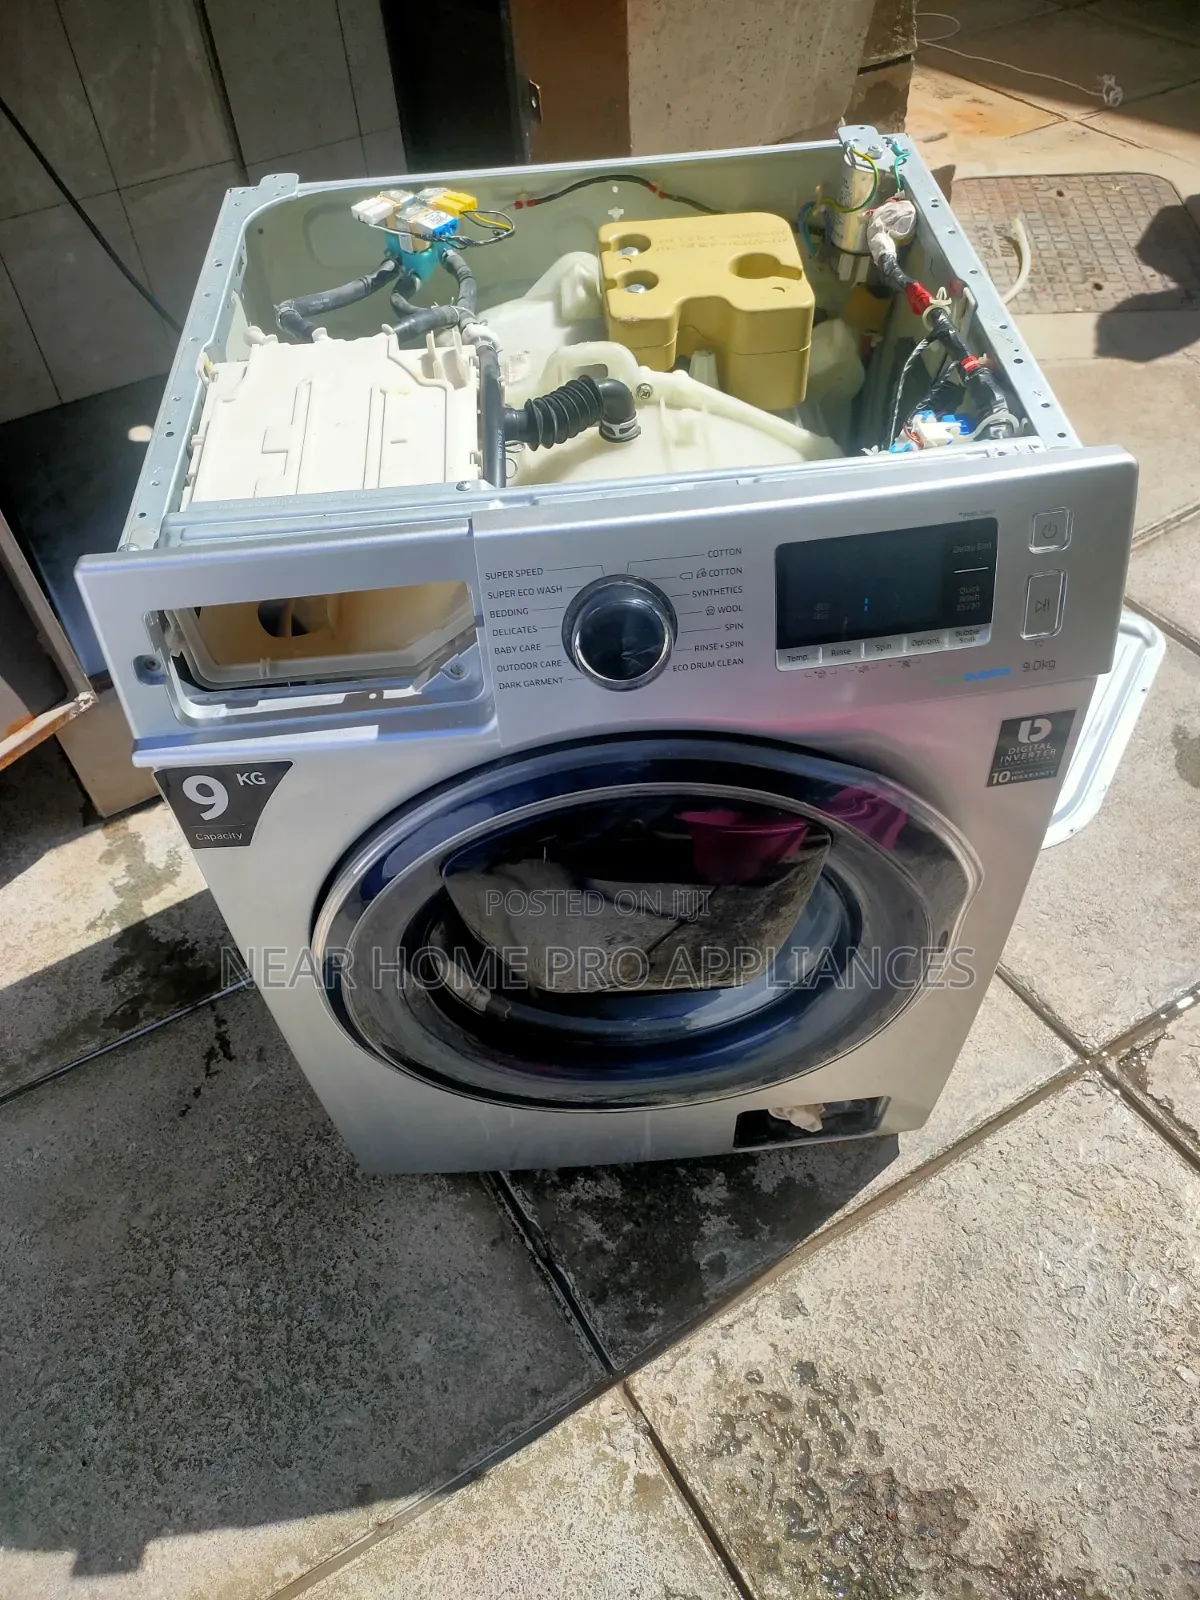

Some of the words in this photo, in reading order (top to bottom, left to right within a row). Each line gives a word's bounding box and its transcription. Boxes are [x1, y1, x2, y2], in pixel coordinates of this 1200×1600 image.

[707, 548, 742, 558] COTTON
[485, 570, 513, 580] SUPER
[516, 568, 543, 577] SPEED
[709, 567, 743, 577] COTTON
[488, 590, 515, 599] SUPER
[518, 588, 535, 597] ECO
[537, 586, 563, 595] WASH
[692, 586, 743, 598] SYNTHETICS
[490, 608, 529, 618] BEDDING
[717, 605, 743, 614] WOOL
[492, 626, 538, 636] DELICATES
[724, 623, 744, 631] SPIN
[694, 643, 718, 652] RINSE
[725, 640, 744, 649] SPIN
[875, 643, 892, 652] Spin
[911, 637, 940, 647] Options
[494, 646, 517, 655] BABY
[520, 644, 542, 653] CARE
[831, 648, 852, 657] Rinse
[497, 662, 538, 672] OUTDOOR
[540, 660, 562, 669] CARE
[672, 663, 689, 672] ECO
[691, 661, 715, 670] DRUM
[717, 658, 744, 667] CLEAN
[1022, 659, 1056, 672] 9.0kg
[499, 681, 522, 690] DARK
[523, 677, 564, 688] GARMENT
[1008, 743, 1052, 755] DIGITAL
[1000, 748, 1057, 763] INVERTER
[992, 770, 1011, 784] 10
[182, 774, 229, 821] 9
[236, 771, 267, 786] KG
[195, 831, 243, 842] Capacity
